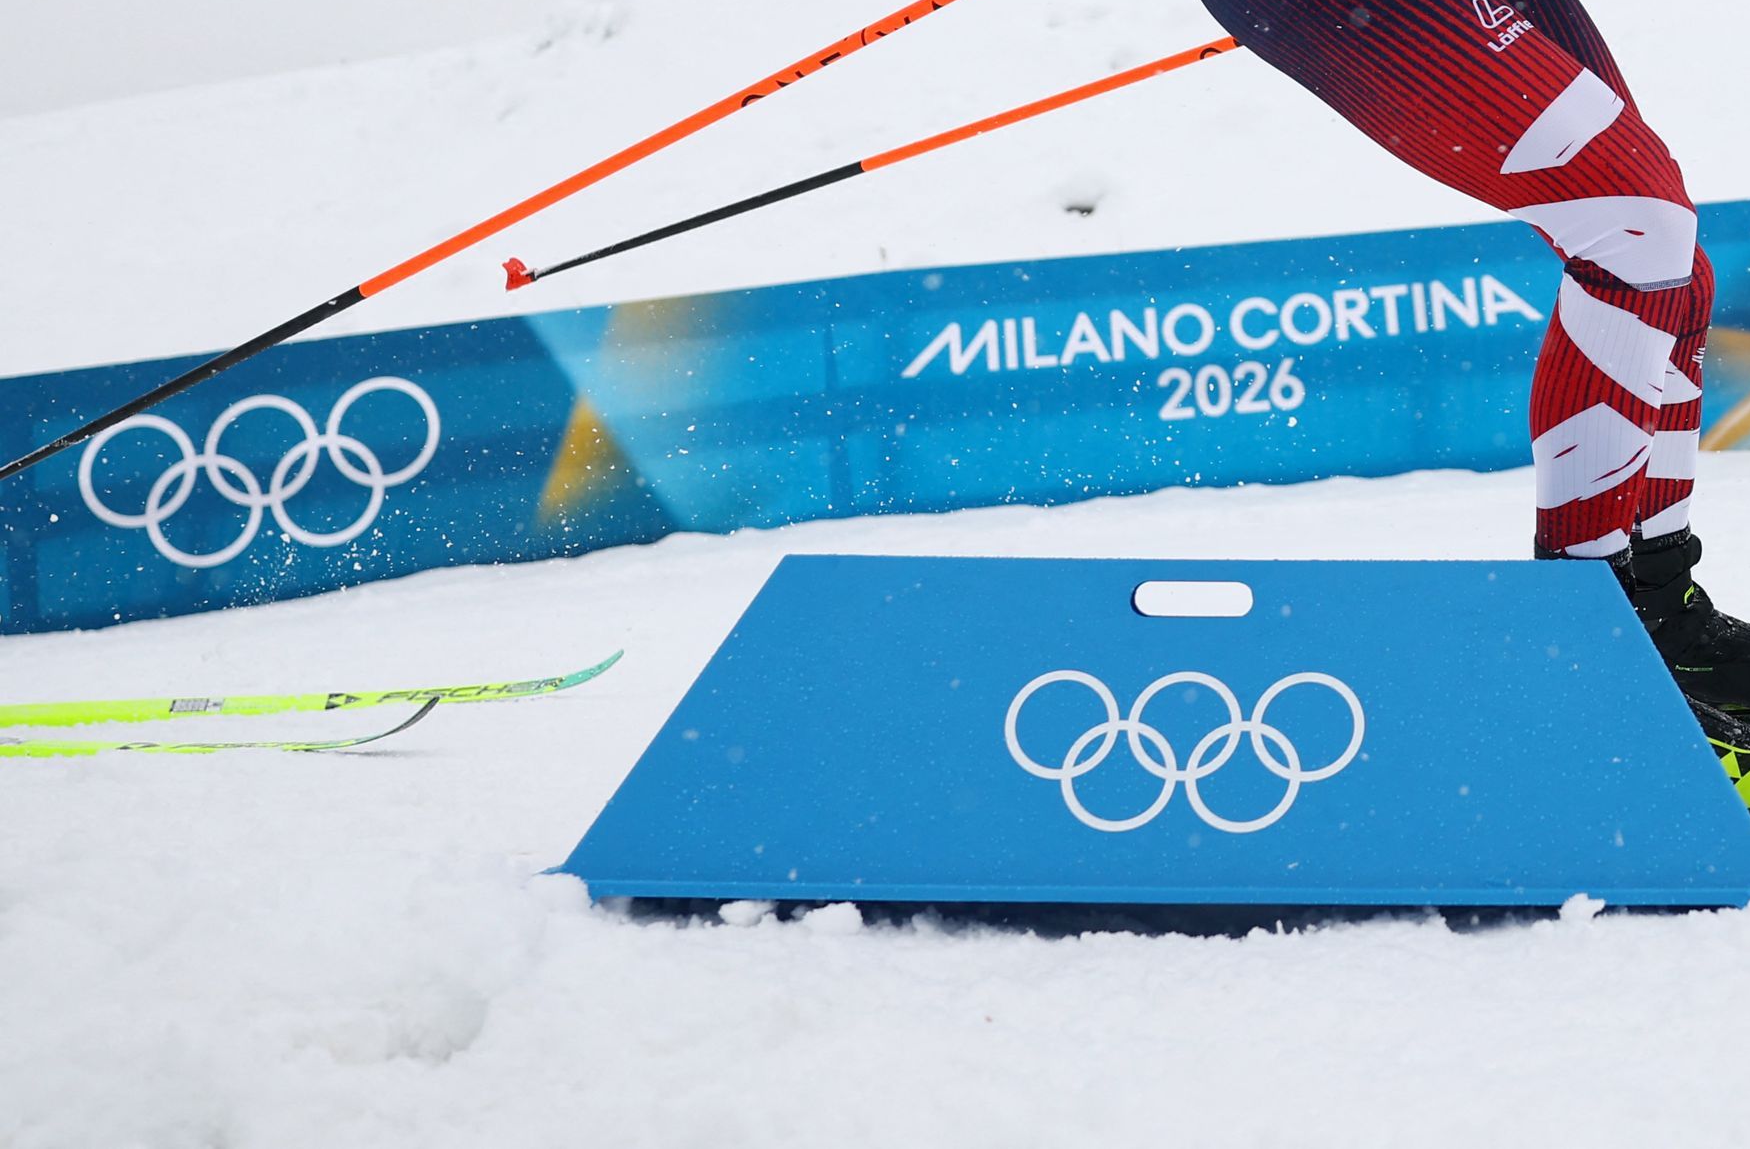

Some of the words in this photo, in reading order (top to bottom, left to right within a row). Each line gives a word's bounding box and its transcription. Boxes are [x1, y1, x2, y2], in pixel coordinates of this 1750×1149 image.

[1487, 19, 1534, 52] Löffle
[901, 302, 1215, 378] MILANO
[1229, 275, 1544, 350] CORTINA
[1157, 358, 1305, 420] 2026
